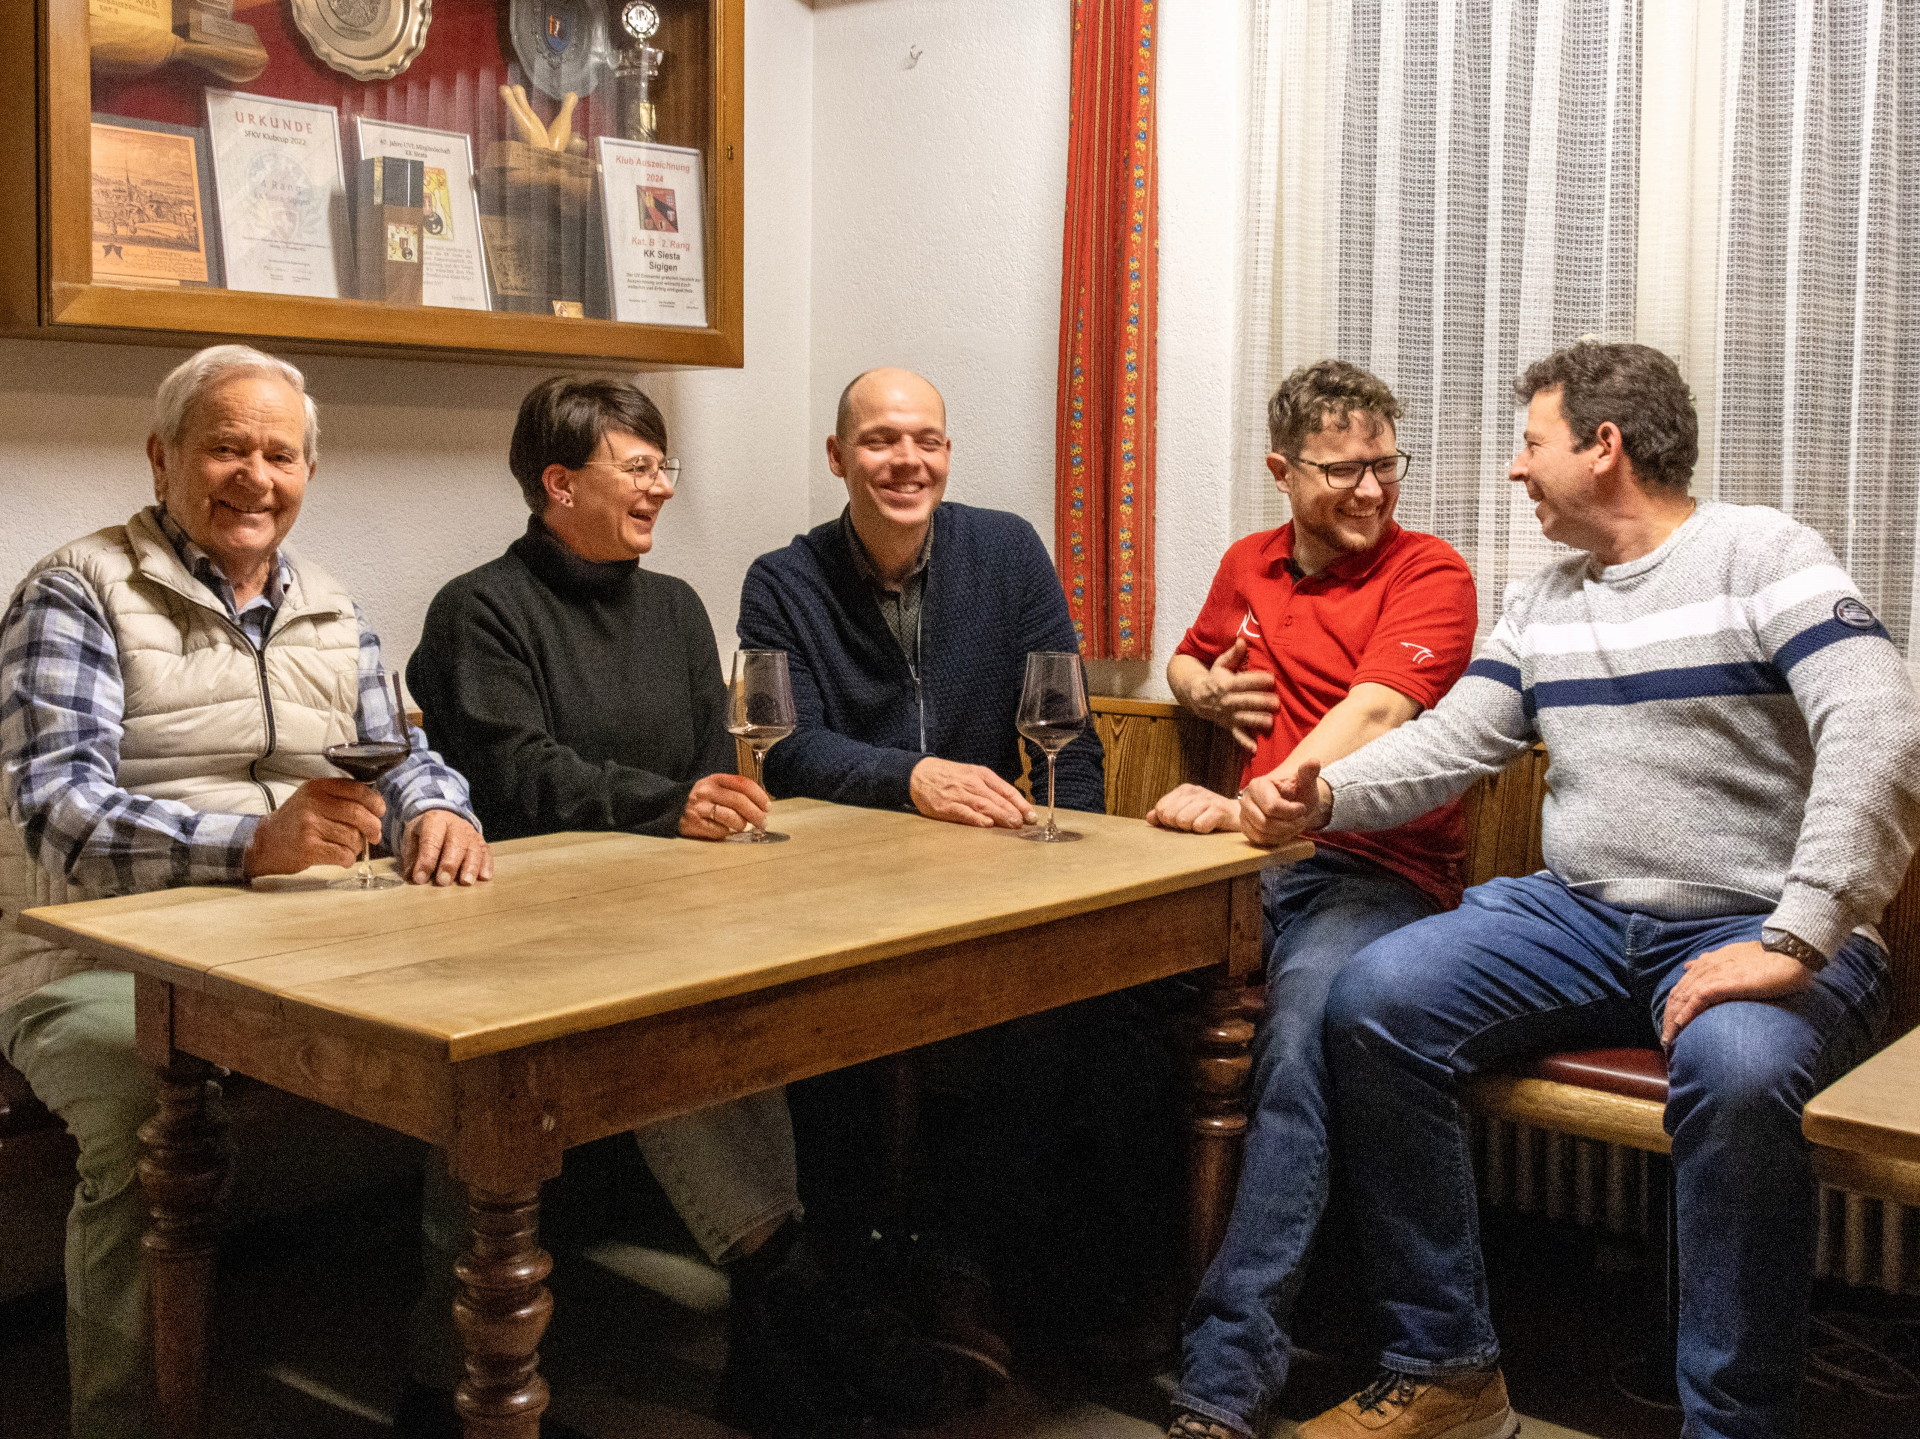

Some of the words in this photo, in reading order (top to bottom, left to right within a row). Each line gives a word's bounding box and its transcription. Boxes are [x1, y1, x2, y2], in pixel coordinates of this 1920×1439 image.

[235, 111, 313, 134] URKUNDE
[244, 130, 261, 139] SFKV
[262, 133, 289, 145] Klubcup
[290, 136, 307, 146] 2022
[615, 154, 634, 165] Klub
[636, 157, 690, 174] Auszeichnung
[646, 173, 664, 183] 2024
[631, 236, 647, 247] Kat.
[648, 237, 655, 247] B
[661, 238, 669, 248] 2.
[670, 240, 691, 252] Rang
[643, 249, 655, 258] KK
[657, 250, 681, 261] Siesta
[649, 261, 678, 273] Sigigen
